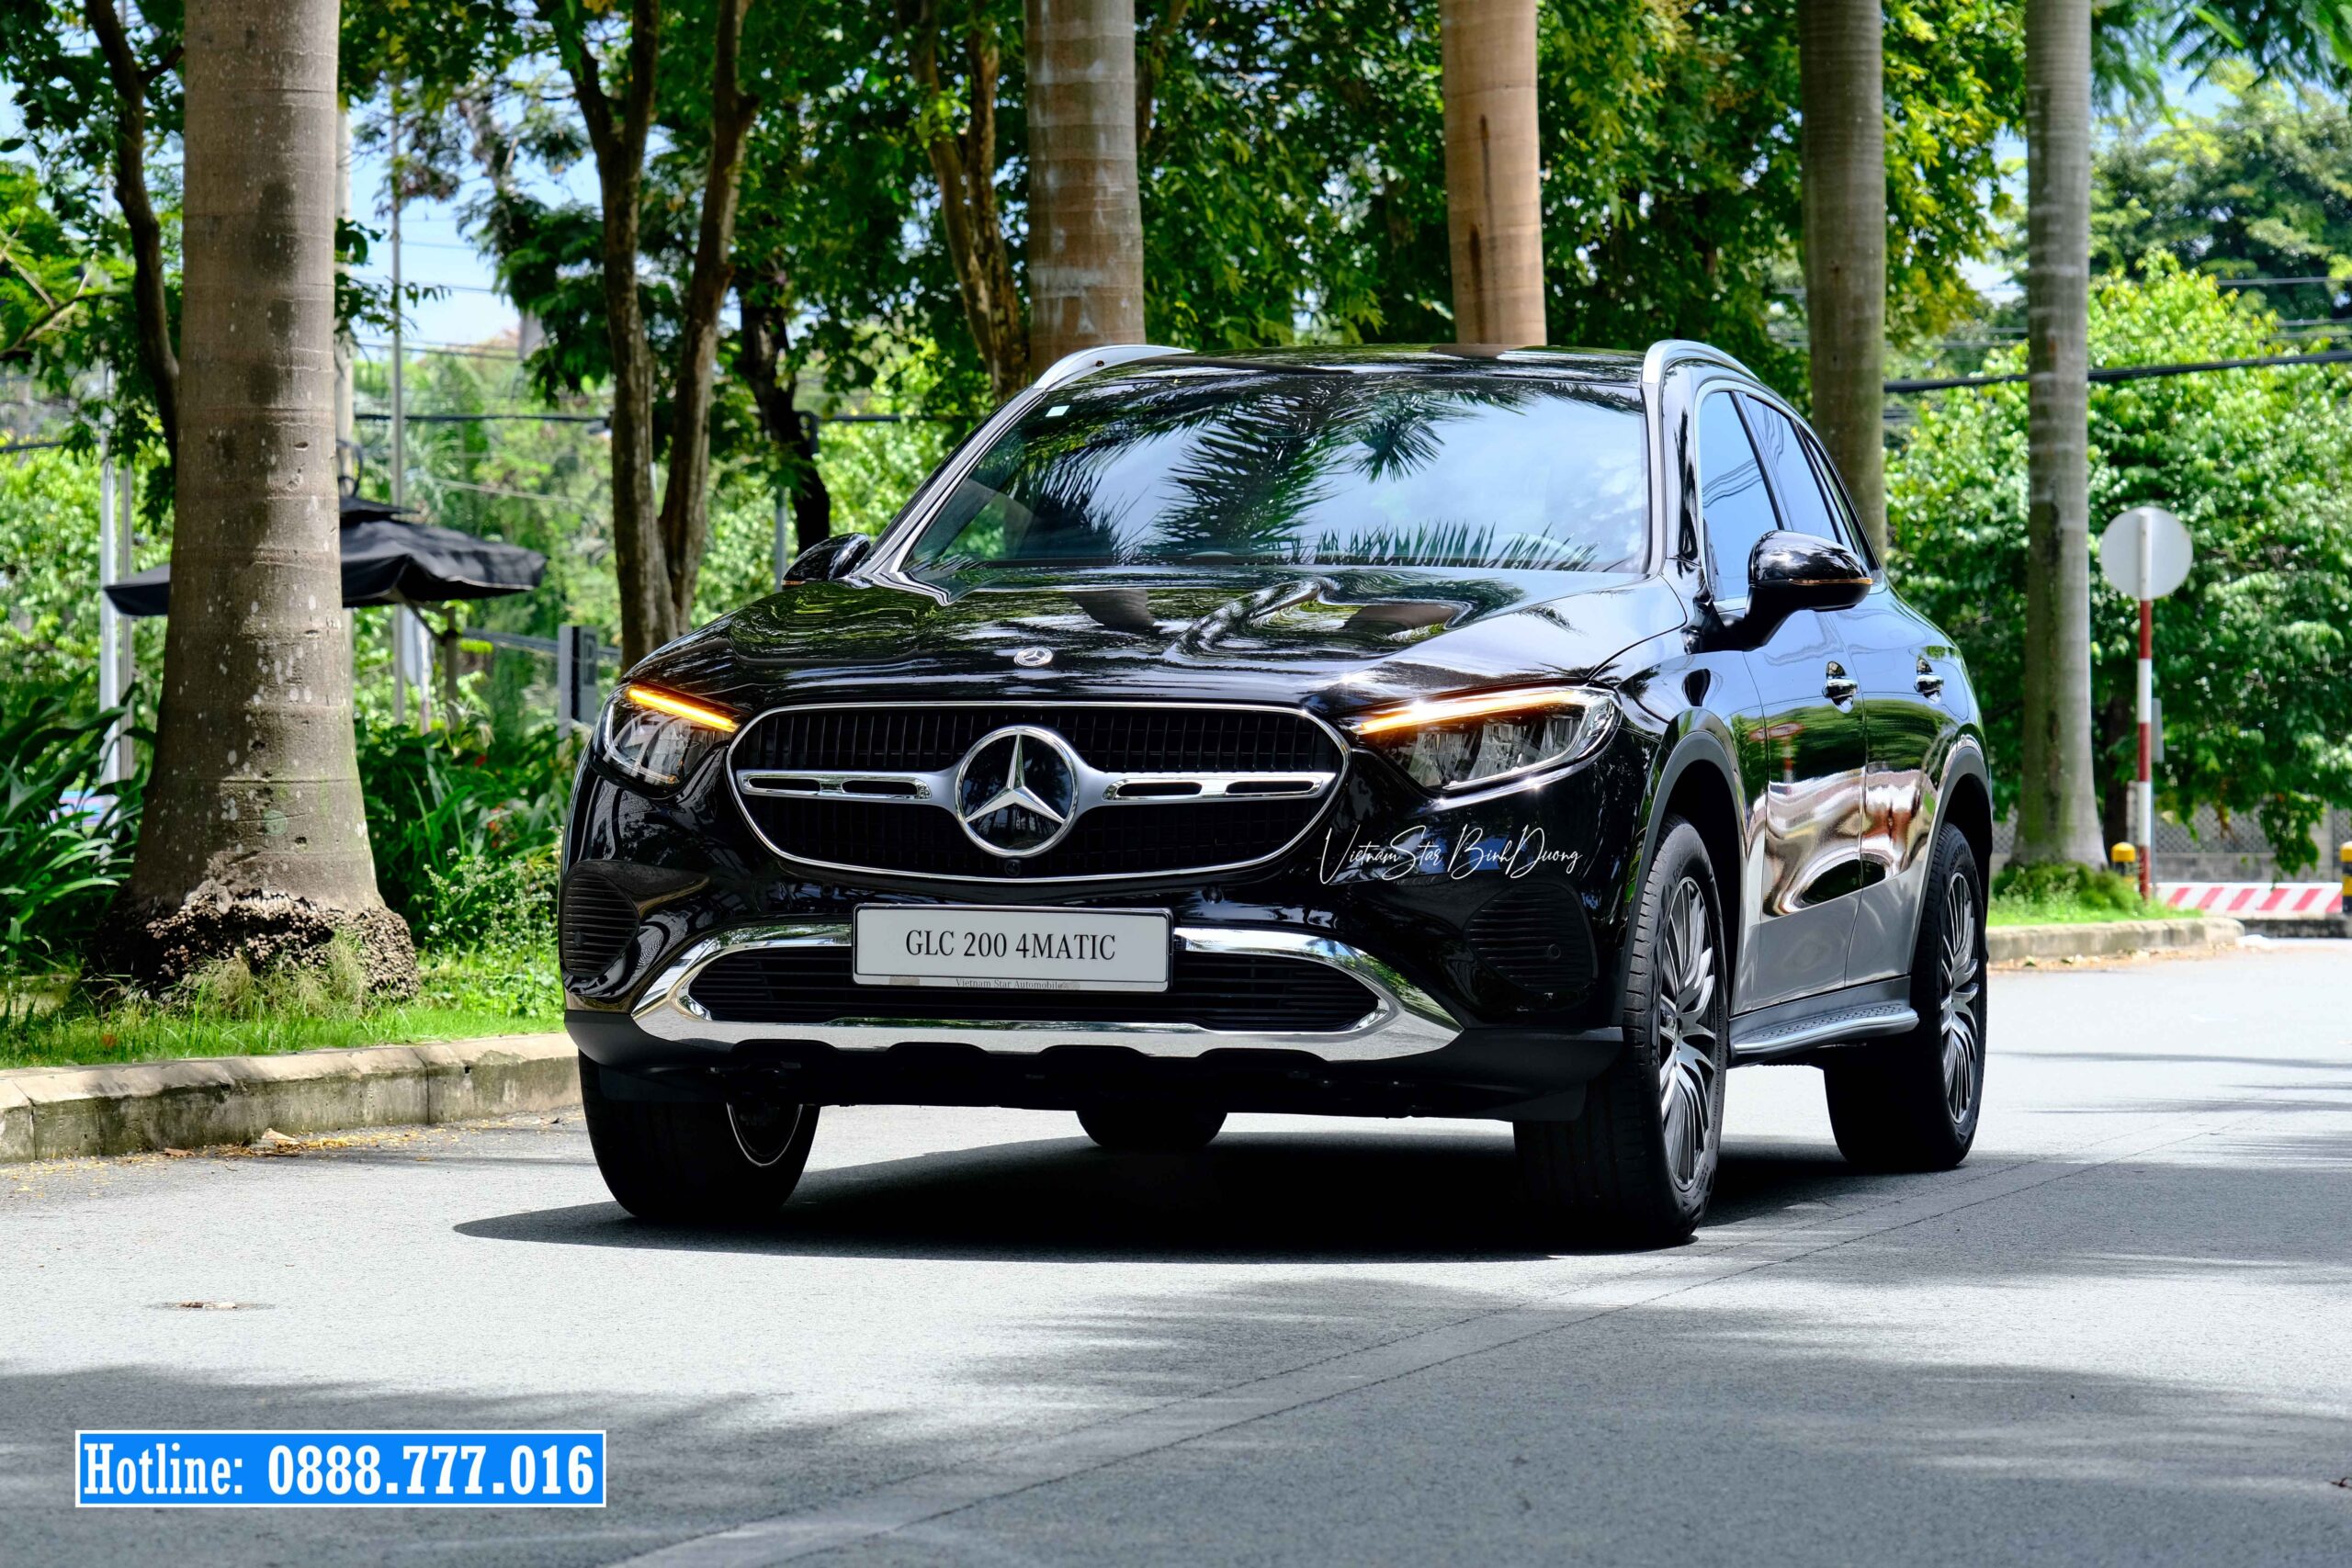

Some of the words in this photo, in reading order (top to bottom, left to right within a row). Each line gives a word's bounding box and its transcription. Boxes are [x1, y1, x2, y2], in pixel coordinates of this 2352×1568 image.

[906, 930, 955, 956] GLC
[963, 931, 1007, 957] 200
[1015, 933, 1115, 960] 4MATIC
[956, 977, 991, 988] Vietnam
[993, 978, 1012, 989] Star
